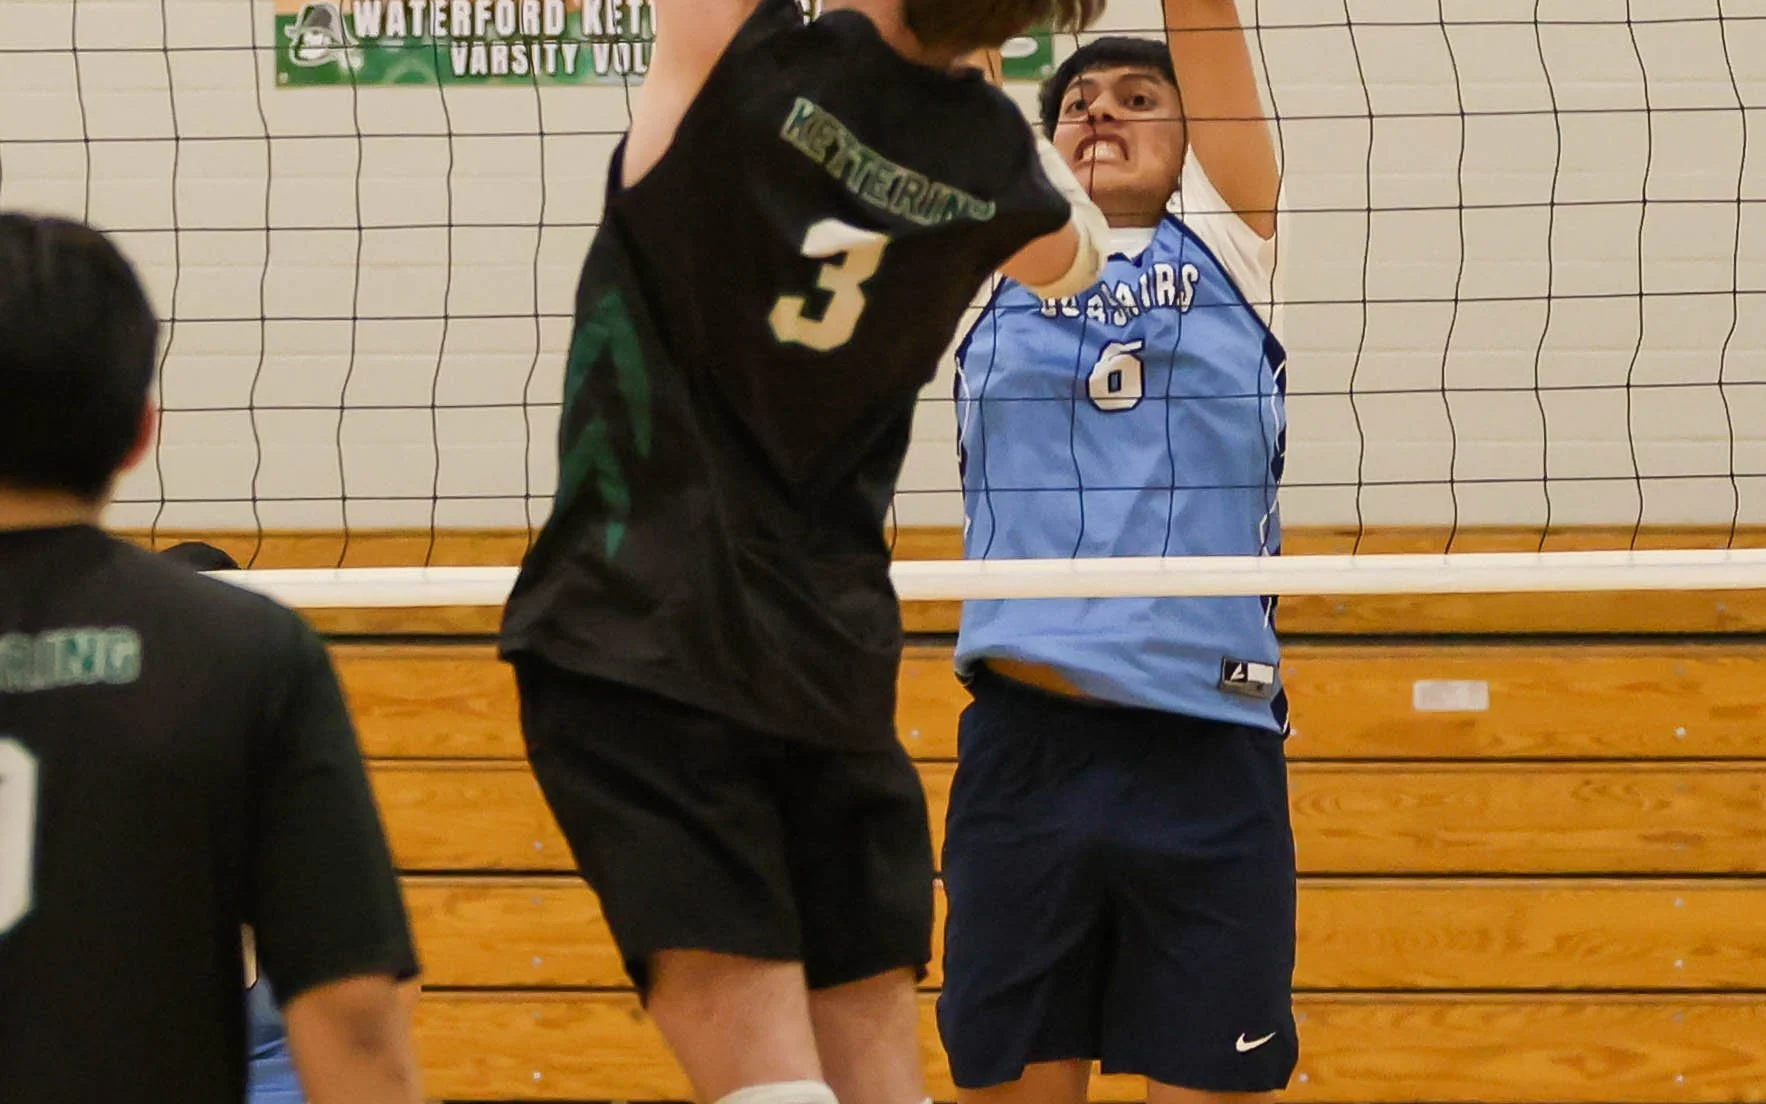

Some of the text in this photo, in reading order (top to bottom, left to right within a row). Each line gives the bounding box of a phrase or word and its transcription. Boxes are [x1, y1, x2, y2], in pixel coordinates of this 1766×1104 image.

[451, 41, 579, 77] VARSITY
[768, 217, 890, 353] 3
[1087, 339, 1145, 413] 6
